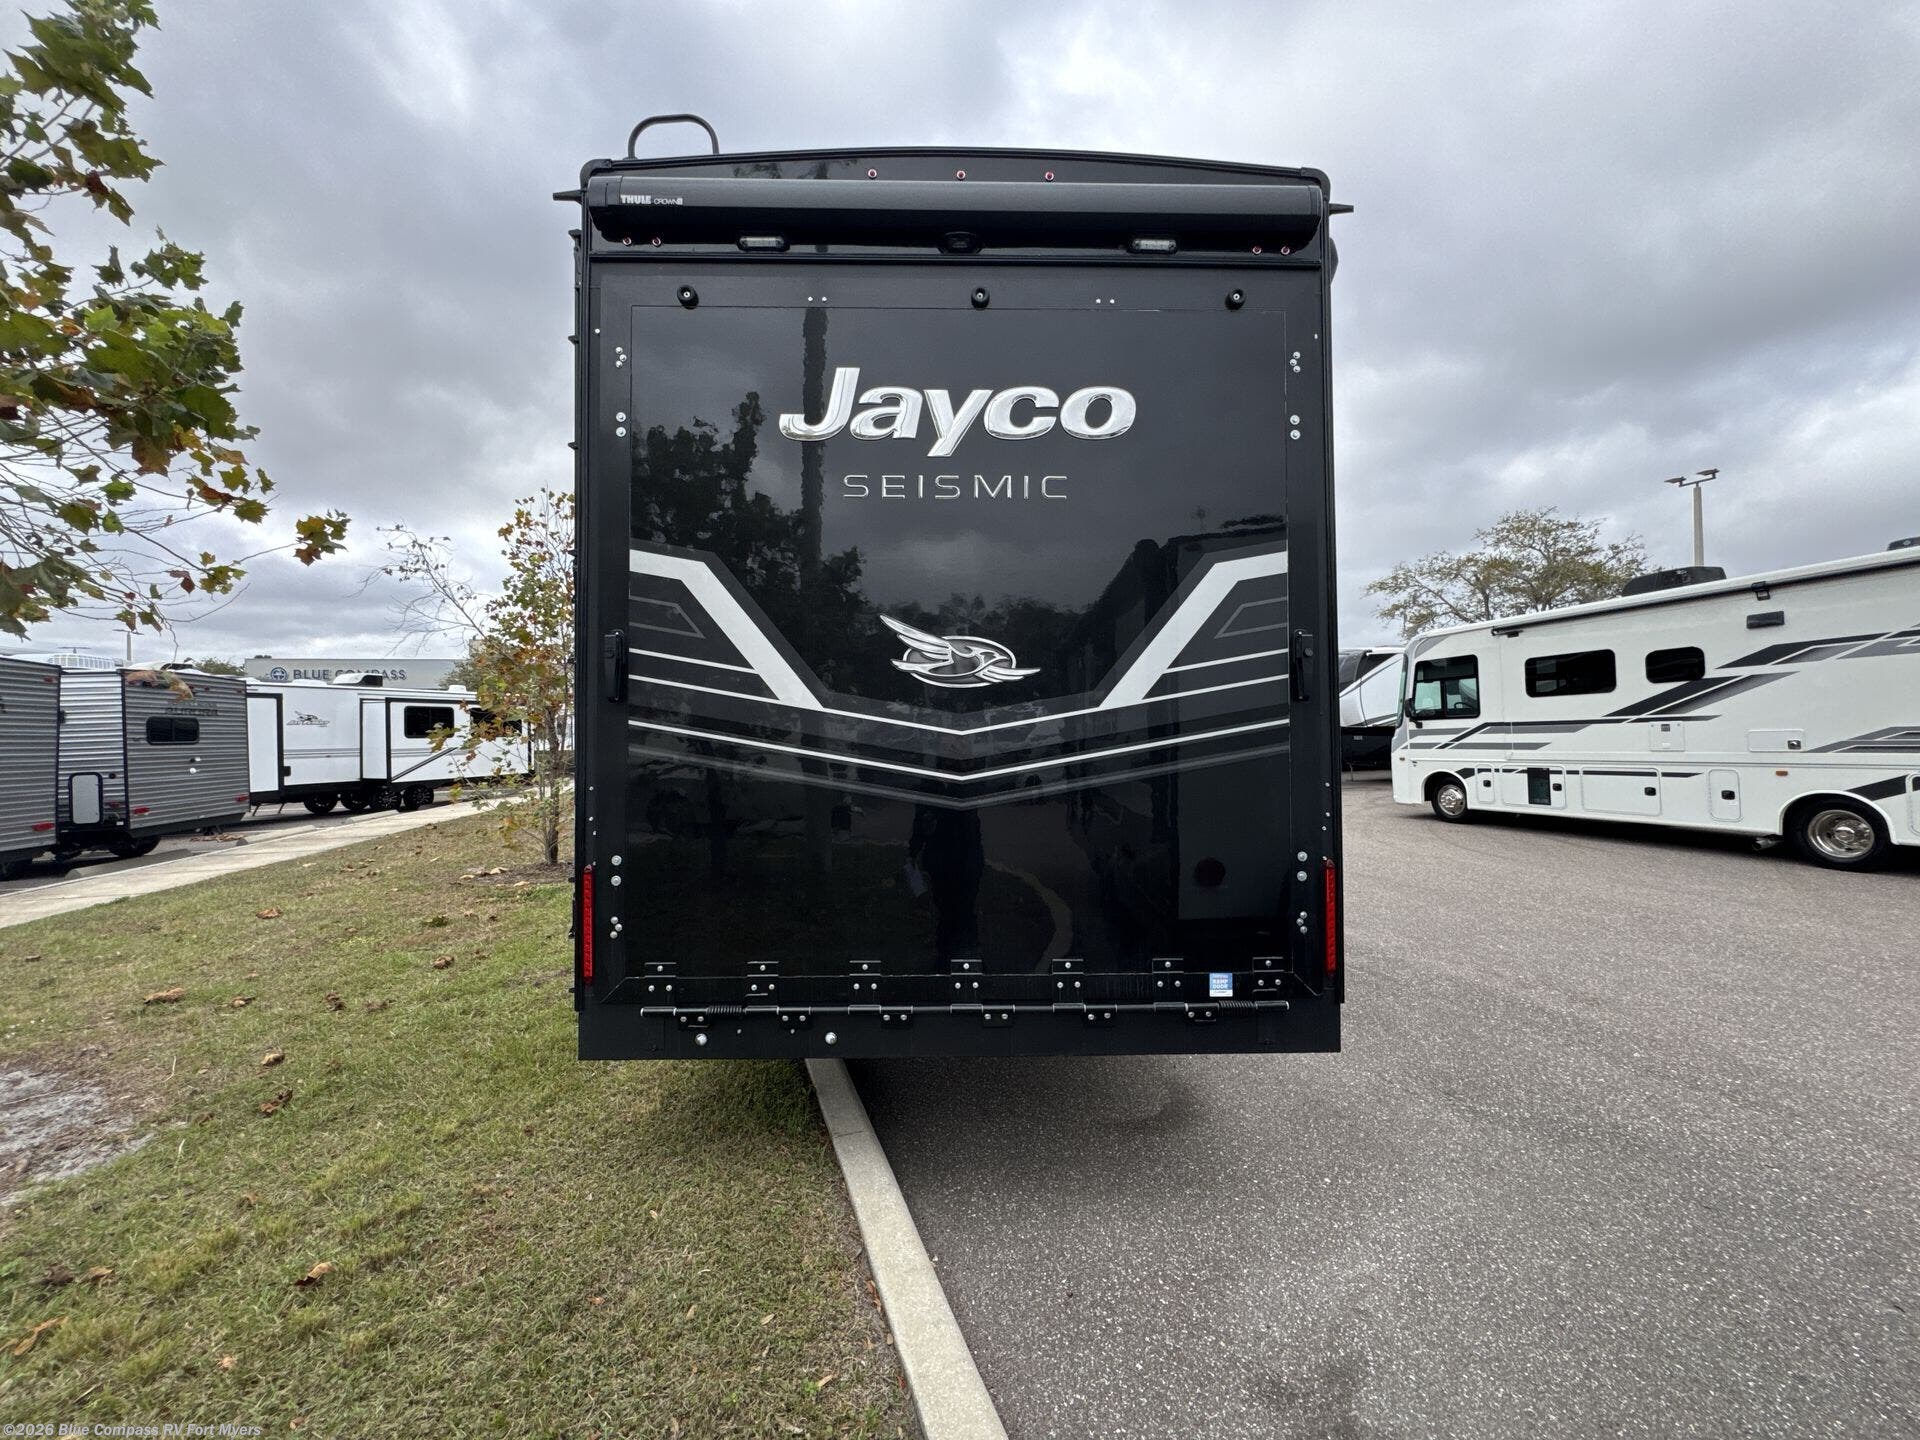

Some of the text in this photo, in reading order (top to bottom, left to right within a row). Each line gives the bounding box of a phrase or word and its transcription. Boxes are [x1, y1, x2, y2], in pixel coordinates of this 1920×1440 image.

[621, 194, 651, 204] THULE
[779, 367, 1136, 457] Jayco
[843, 474, 1068, 499] SEISMIC
[293, 669, 332, 680] BLUE
